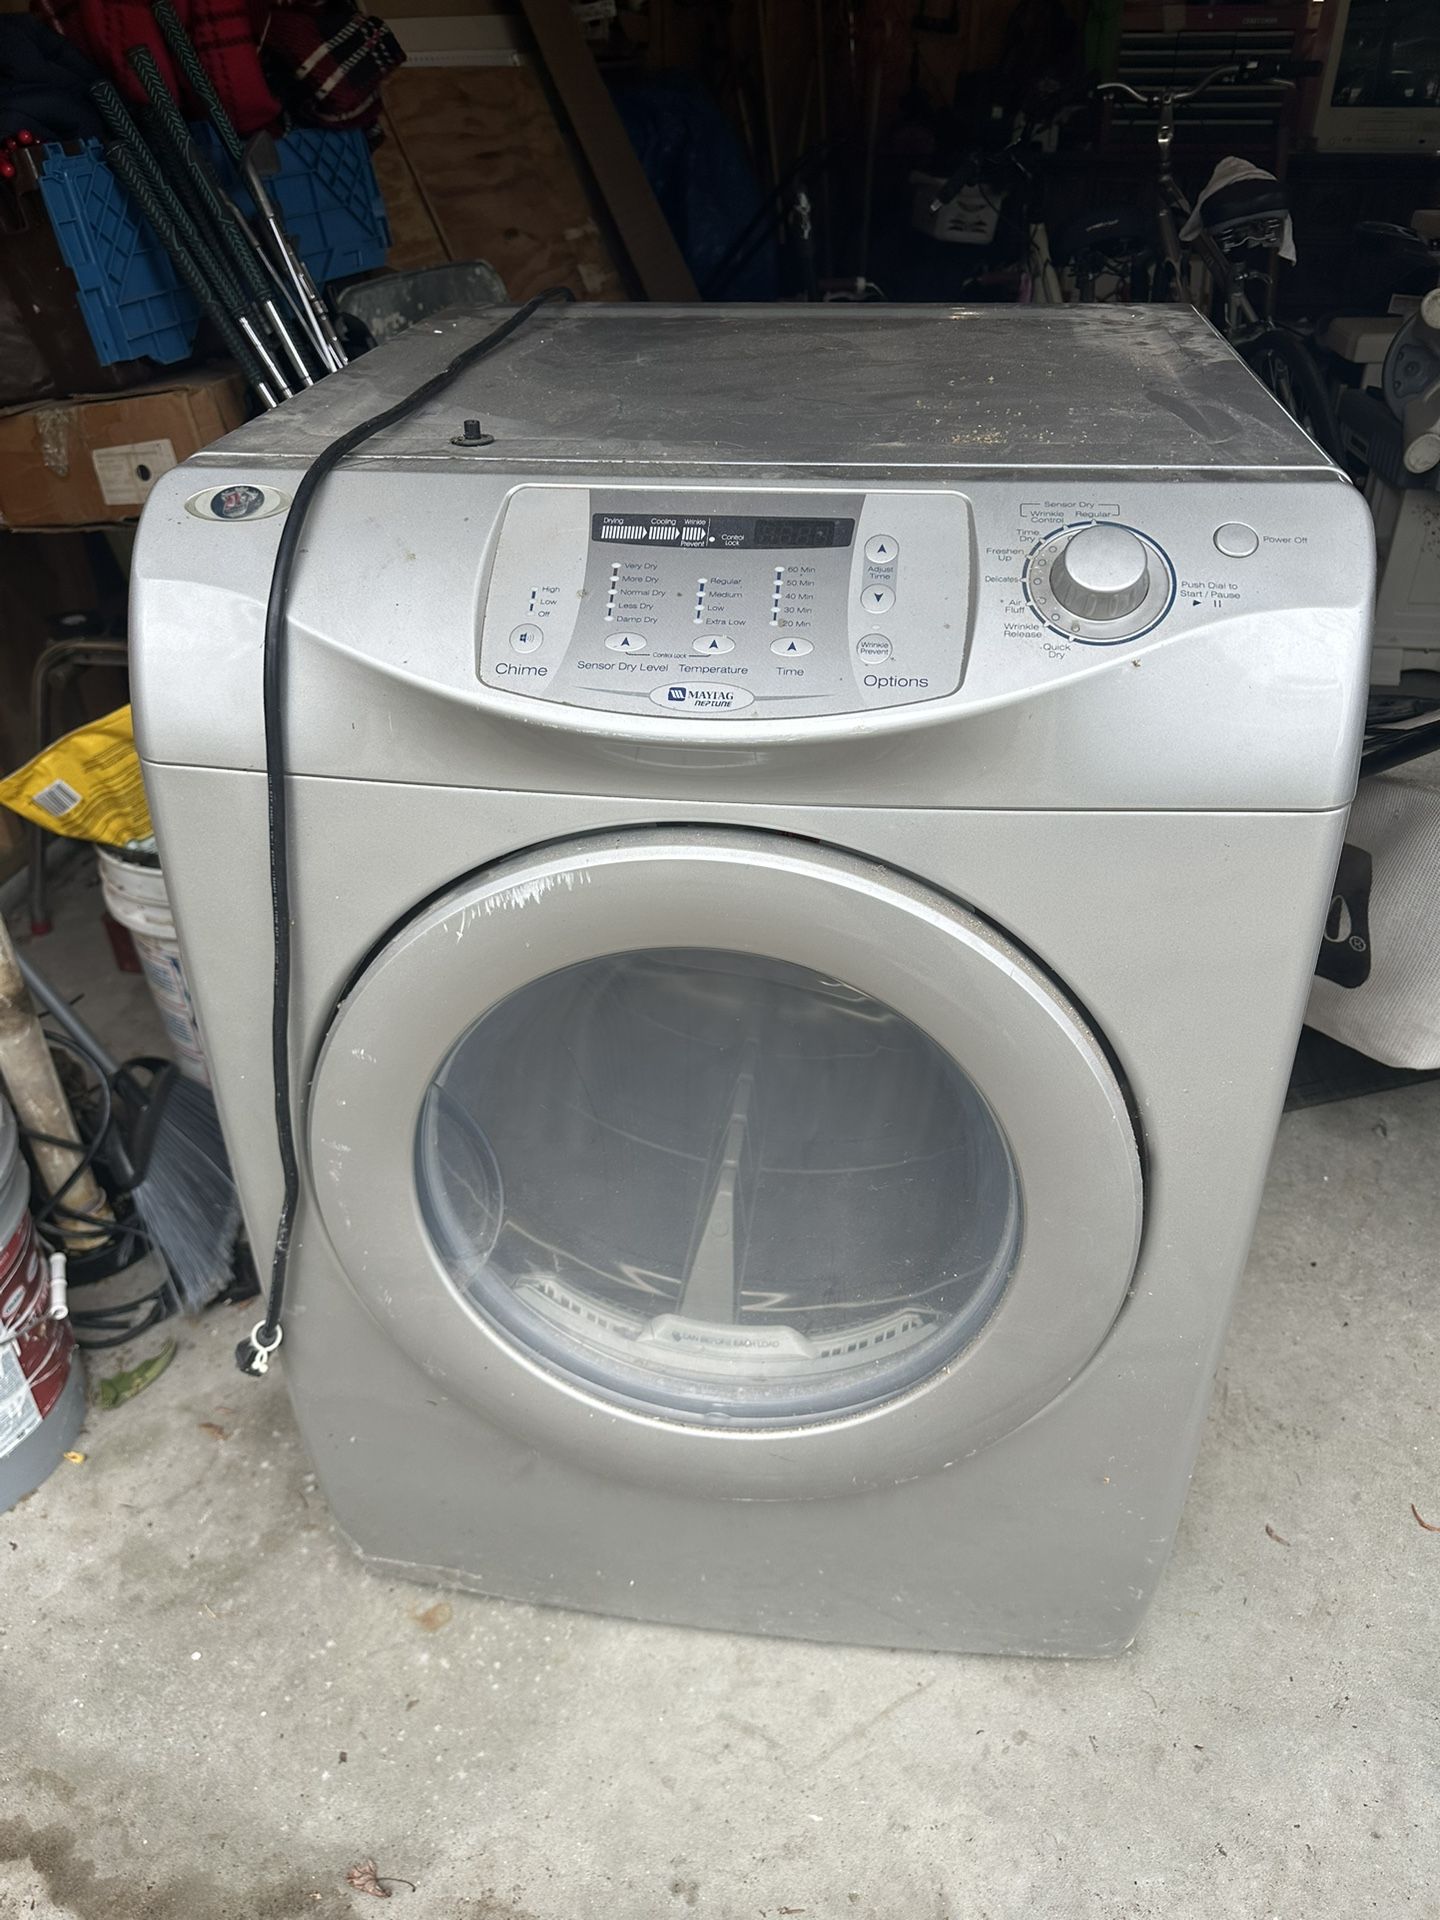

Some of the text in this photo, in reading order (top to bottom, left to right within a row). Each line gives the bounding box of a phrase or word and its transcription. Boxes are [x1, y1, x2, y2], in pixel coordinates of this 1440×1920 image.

[603, 517, 624, 525] Drying
[651, 518, 677, 526] Cooling
[867, 566, 894, 574] Adjust
[644, 576, 659, 584] Dry
[710, 578, 742, 586] Regular
[1181, 581, 1205, 589] Push
[651, 589, 666, 597] Dry
[1180, 590, 1203, 598] Start
[1211, 591, 1241, 599] Pause
[639, 603, 654, 611] Dry
[616, 616, 658, 624] Damp Dry
[1043, 643, 1071, 651] Quick
[1049, 651, 1065, 659] Dry
[495, 663, 548, 677] Chime
[577, 660, 669, 674] Sensor Dry Level
[679, 664, 748, 675] Temperature
[776, 667, 804, 677] Time
[863, 674, 929, 688] Options
[688, 690, 734, 700] MAYTAG
